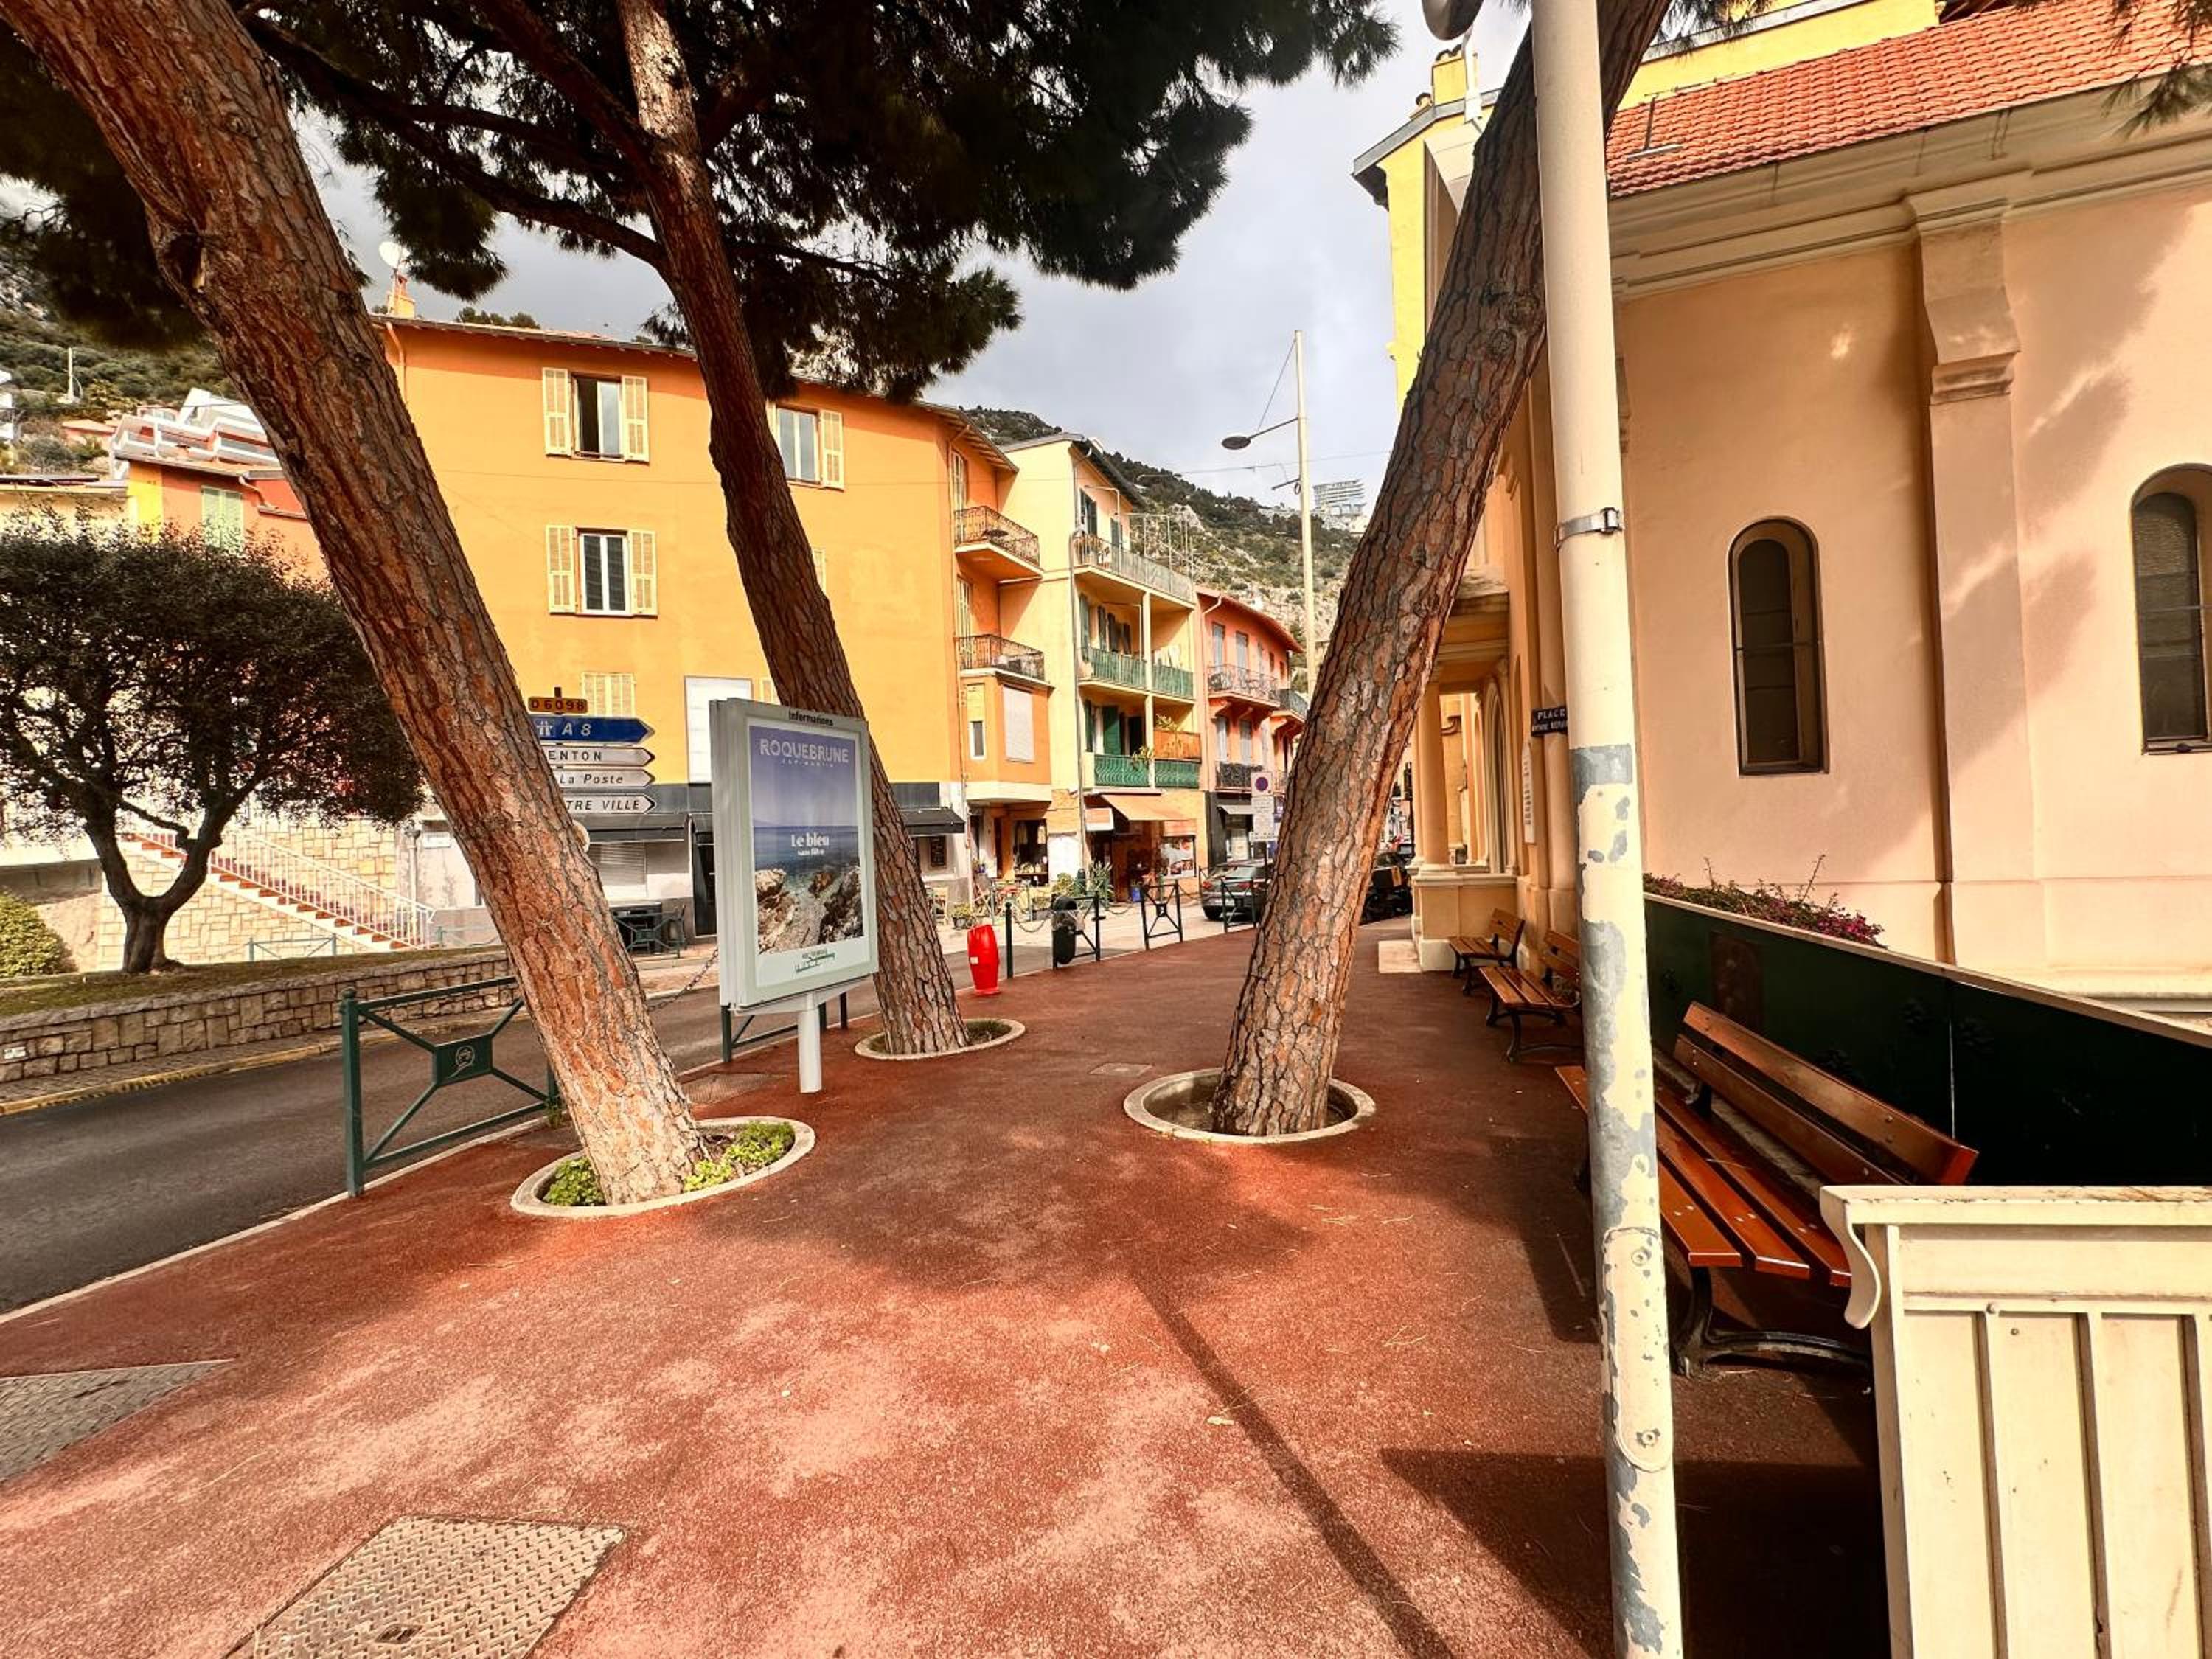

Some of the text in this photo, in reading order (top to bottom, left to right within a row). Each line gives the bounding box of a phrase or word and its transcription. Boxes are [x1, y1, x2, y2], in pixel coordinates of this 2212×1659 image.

[548, 750, 602, 761] ENTON
[759, 738, 849, 763] ROQUEBRUNE
[560, 774, 624, 785] La Poste
[566, 800, 640, 810] TRE VILLE
[790, 832, 830, 848] Le bleu
